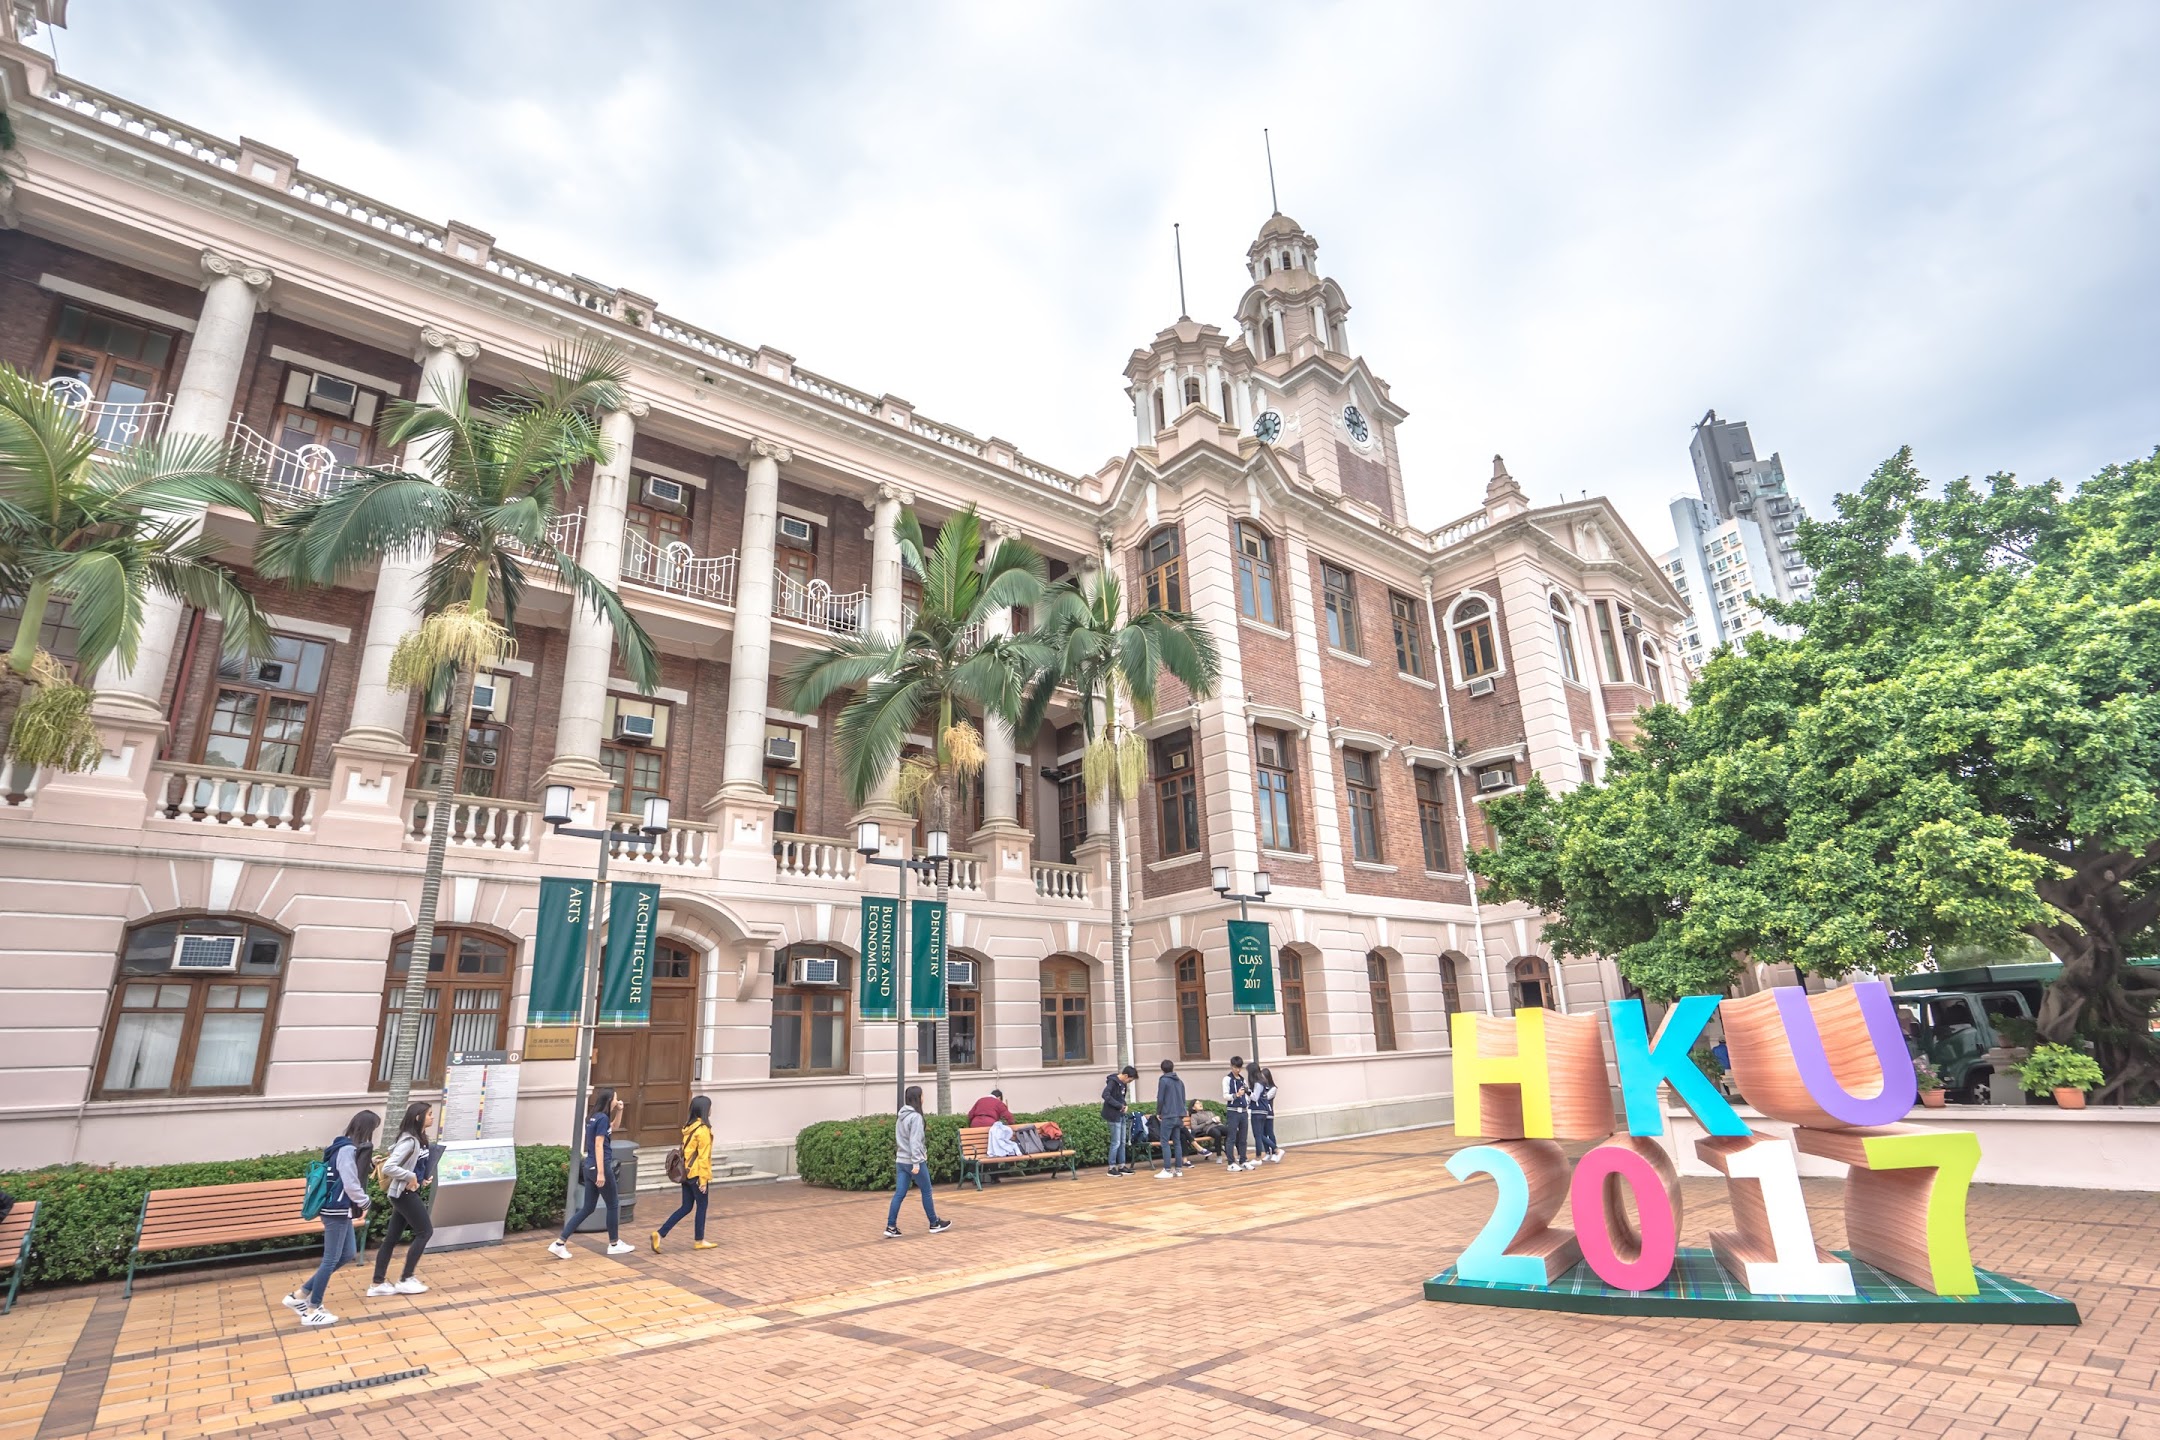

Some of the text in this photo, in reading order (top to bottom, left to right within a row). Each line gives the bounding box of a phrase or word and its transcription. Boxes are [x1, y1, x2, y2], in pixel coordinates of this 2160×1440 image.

[567, 887, 584, 923] ARTS
[629, 892, 651, 1003] ARCHITECTURE
[867, 905, 880, 982] ECONOMICS
[880, 906, 893, 996] BUSINESS AND
[930, 909, 941, 978] DENTISTRY
[1238, 954, 1263, 965] CLASS
[1248, 965, 1257, 979] of
[1243, 978, 1261, 989] 2017
[1451, 981, 1917, 1138] HKU
[1444, 1131, 1982, 1296] 2017
